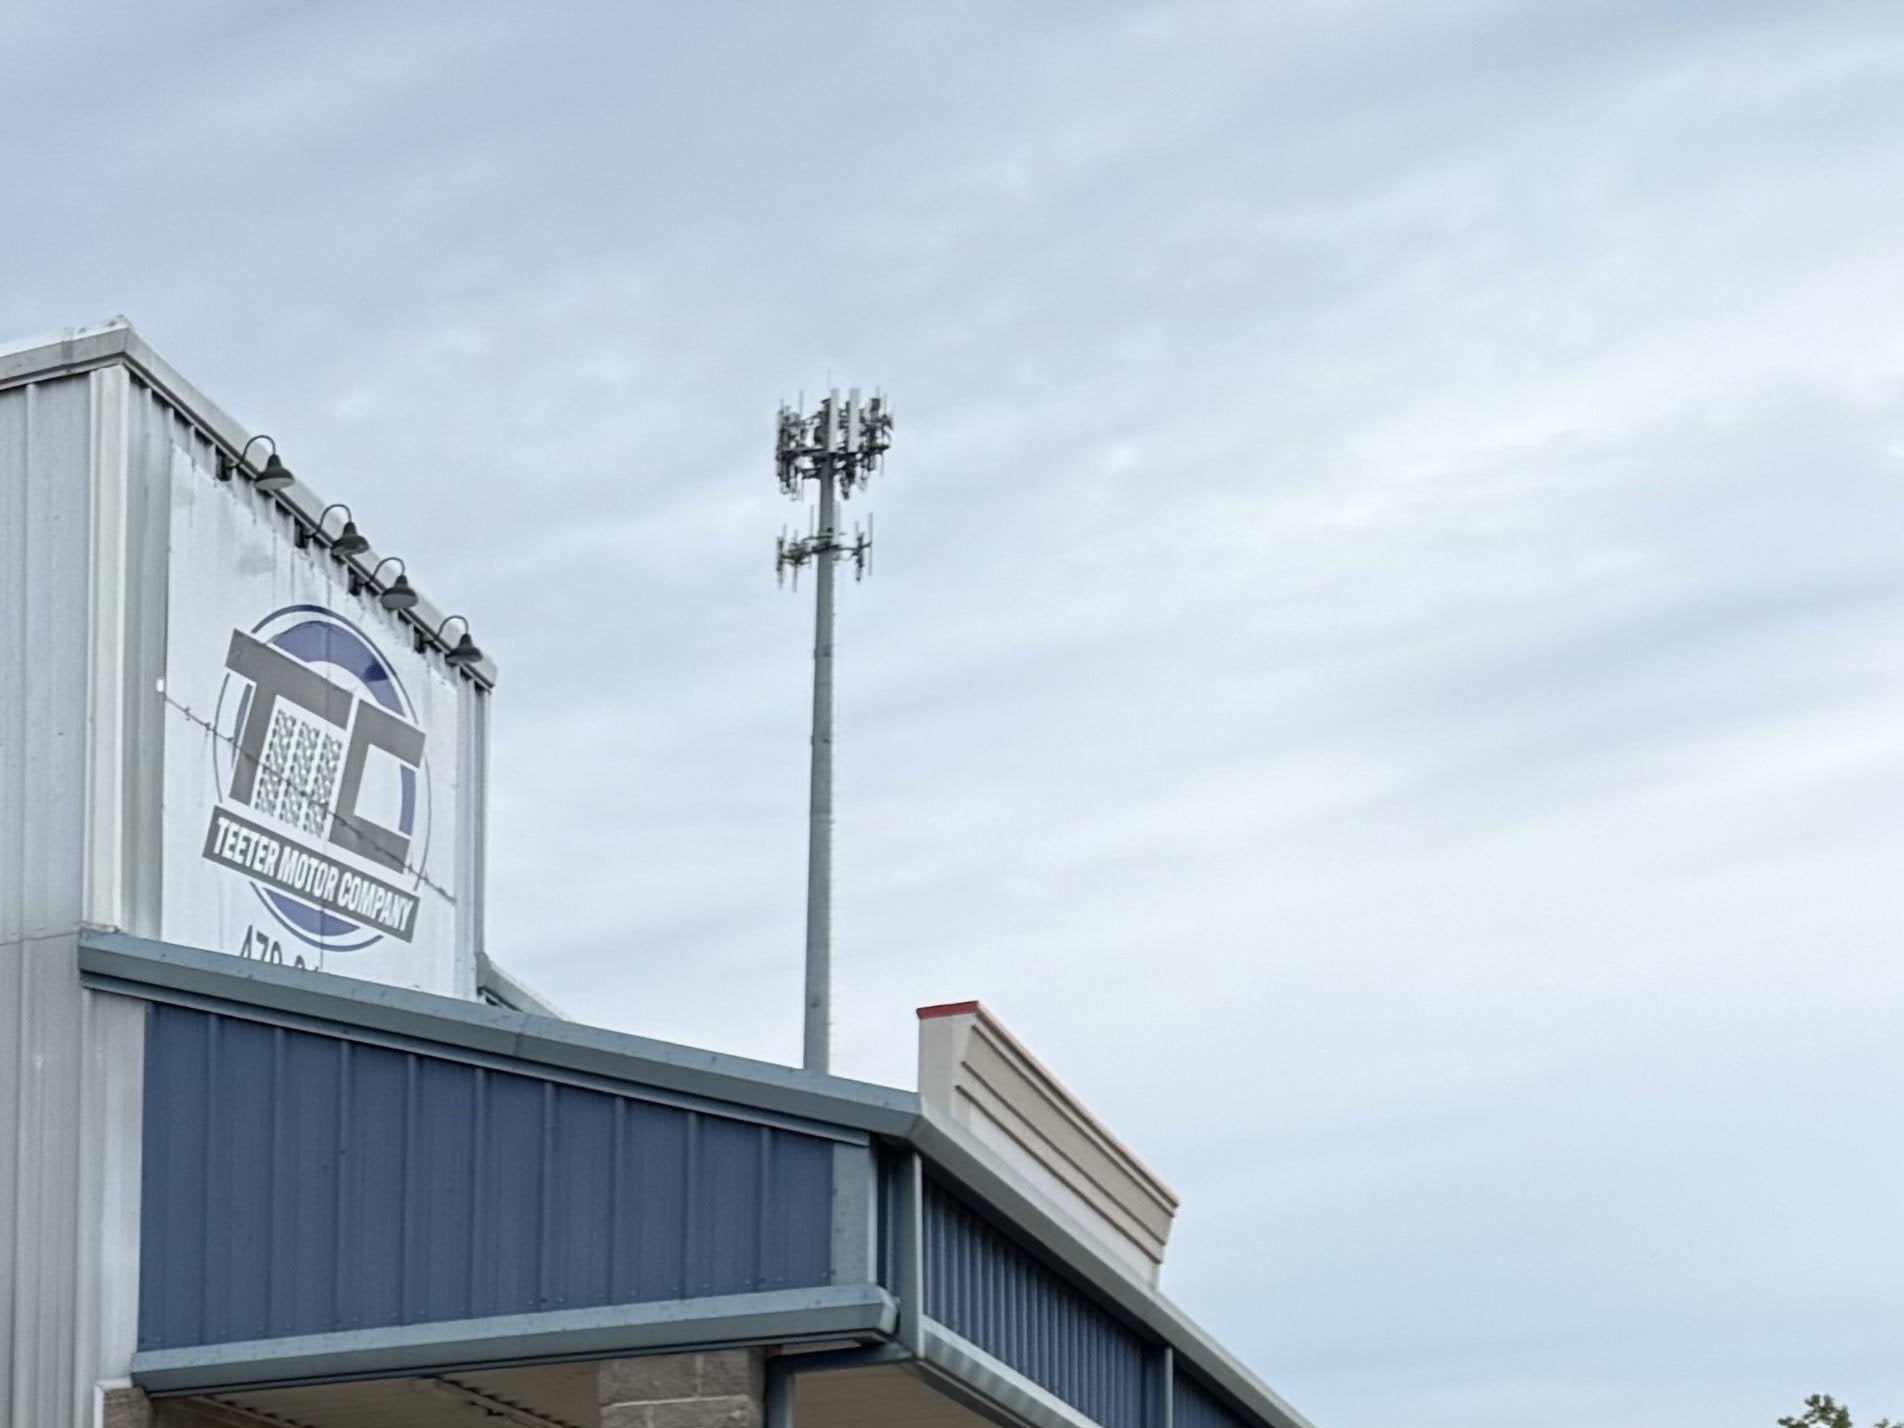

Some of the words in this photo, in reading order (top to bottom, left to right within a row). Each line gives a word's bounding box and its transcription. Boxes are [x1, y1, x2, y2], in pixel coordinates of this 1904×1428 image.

[213, 817, 280, 877] TEETER
[276, 846, 339, 902] MOTOR
[337, 872, 414, 932] COMPANY
